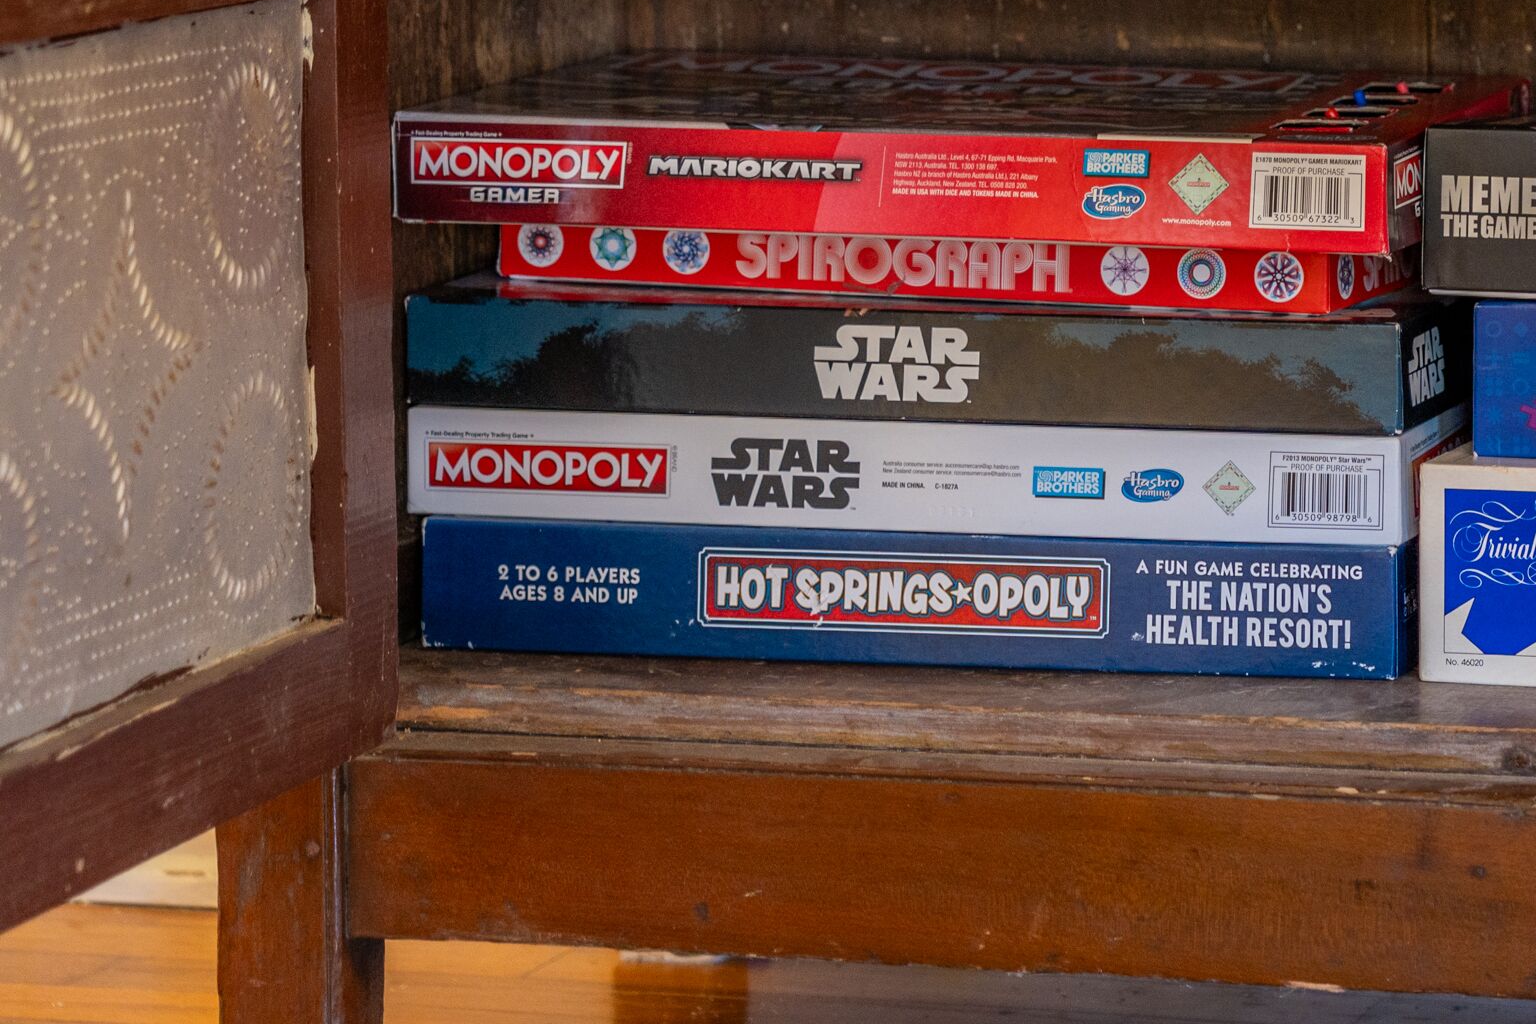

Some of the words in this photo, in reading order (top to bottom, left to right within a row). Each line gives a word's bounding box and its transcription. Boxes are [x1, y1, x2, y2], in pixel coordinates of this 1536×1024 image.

[418, 143, 620, 181] MONOPOLY
[648, 155, 864, 182] MARIOKART
[1086, 163, 1147, 176] BROTHERS
[1101, 152, 1148, 166] PARKER
[470, 187, 560, 205] GAMER
[1090, 185, 1141, 205] Hasbro
[1095, 201, 1132, 214] Gaming
[1161, 217, 1232, 227] www.monopoly.com
[1441, 213, 1478, 238] THE
[1480, 215, 1536, 240] GAME
[735, 235, 1073, 294] SPIROGRAPH
[813, 323, 981, 365] STAR
[1411, 326, 1444, 373] STAR
[814, 362, 980, 404] WARS
[1408, 358, 1445, 407] WARS
[710, 437, 861, 474] STAR
[434, 448, 663, 488] MONOPOLY
[1051, 471, 1100, 484] PARKER
[1290, 463, 1309, 471] PROOF
[1323, 464, 1363, 473] PURCHASE
[711, 473, 860, 510] WARS
[1036, 482, 1100, 495] BROTHERS
[1129, 472, 1179, 490] Hasbro
[1134, 487, 1171, 500] Gaming
[499, 564, 509, 580] 2
[515, 565, 541, 581] TO
[548, 567, 558, 582] 6
[565, 567, 641, 585] PLAYERS
[1135, 559, 1149, 575] A
[1155, 559, 1188, 576] FUN
[1194, 560, 1243, 577] GAME
[1250, 562, 1363, 580] CELEBRATING
[500, 584, 548, 601] AGES
[553, 586, 565, 601] 8
[571, 586, 609, 603] AND
[616, 587, 638, 604] UP
[715, 564, 791, 611] HOT
[793, 567, 954, 618] SPRINGS
[1166, 580, 1213, 610] THE
[1219, 582, 1332, 615] NATION'S
[1145, 614, 1241, 646] HEALTH
[1246, 617, 1352, 649] RESORT!
